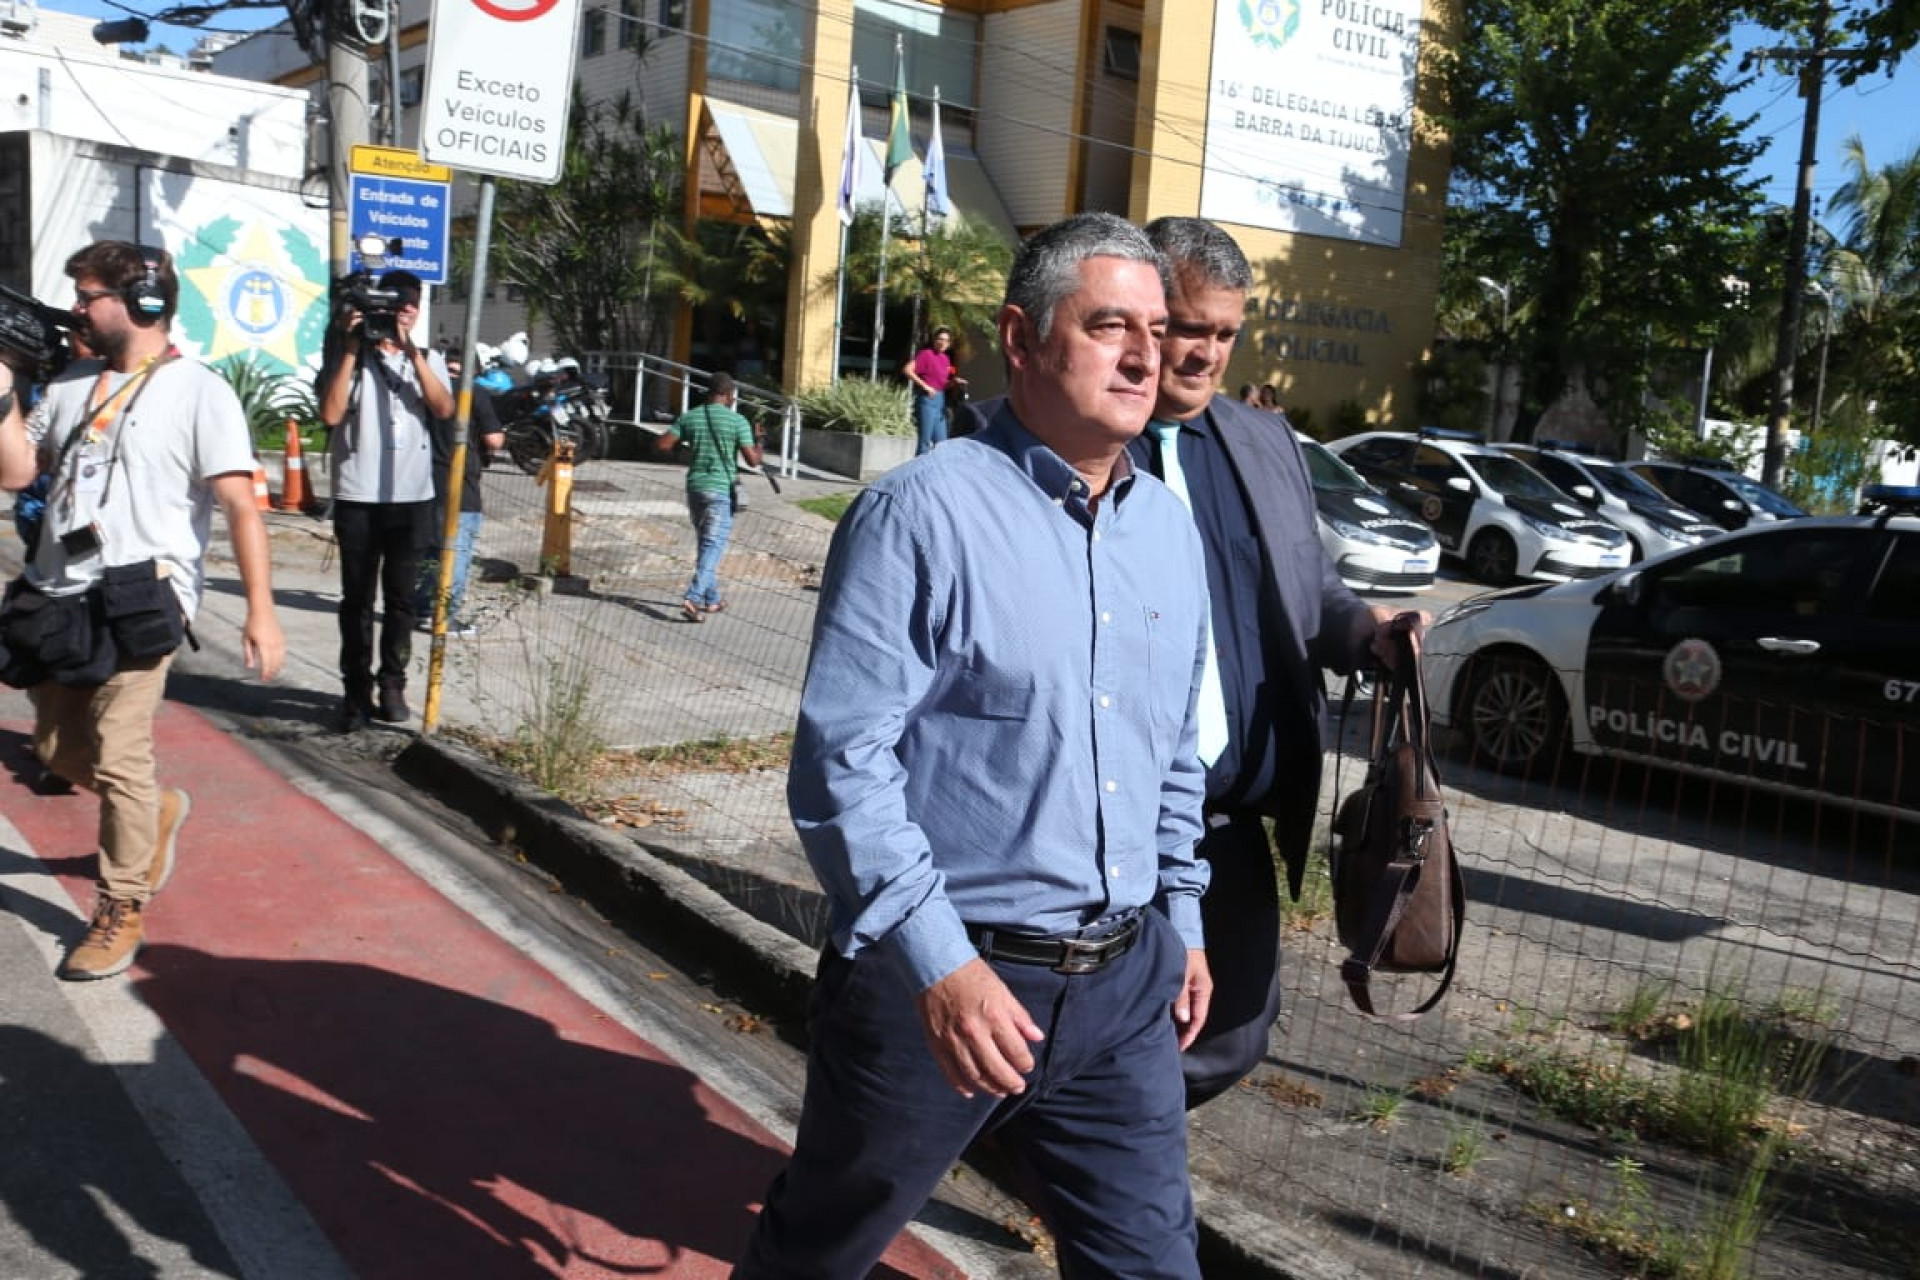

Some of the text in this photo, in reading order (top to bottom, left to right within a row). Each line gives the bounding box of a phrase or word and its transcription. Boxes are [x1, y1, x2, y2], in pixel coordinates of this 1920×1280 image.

[1333, 27, 1389, 59] CIVIL
[457, 70, 540, 102] Exceto
[1252, 86, 1347, 120] DELEGACIA
[445, 98, 546, 133] Veículos
[1235, 110, 1386, 155] BARRA DA TIJUCA
[438, 127, 547, 163] OFICIAIS
[359, 187, 439, 208] Entrada de
[1265, 298, 1391, 334] DELEGACIA
[1261, 333, 1363, 366] POLICIAL
[1589, 705, 1807, 769] POLÍCIA CIVIL
